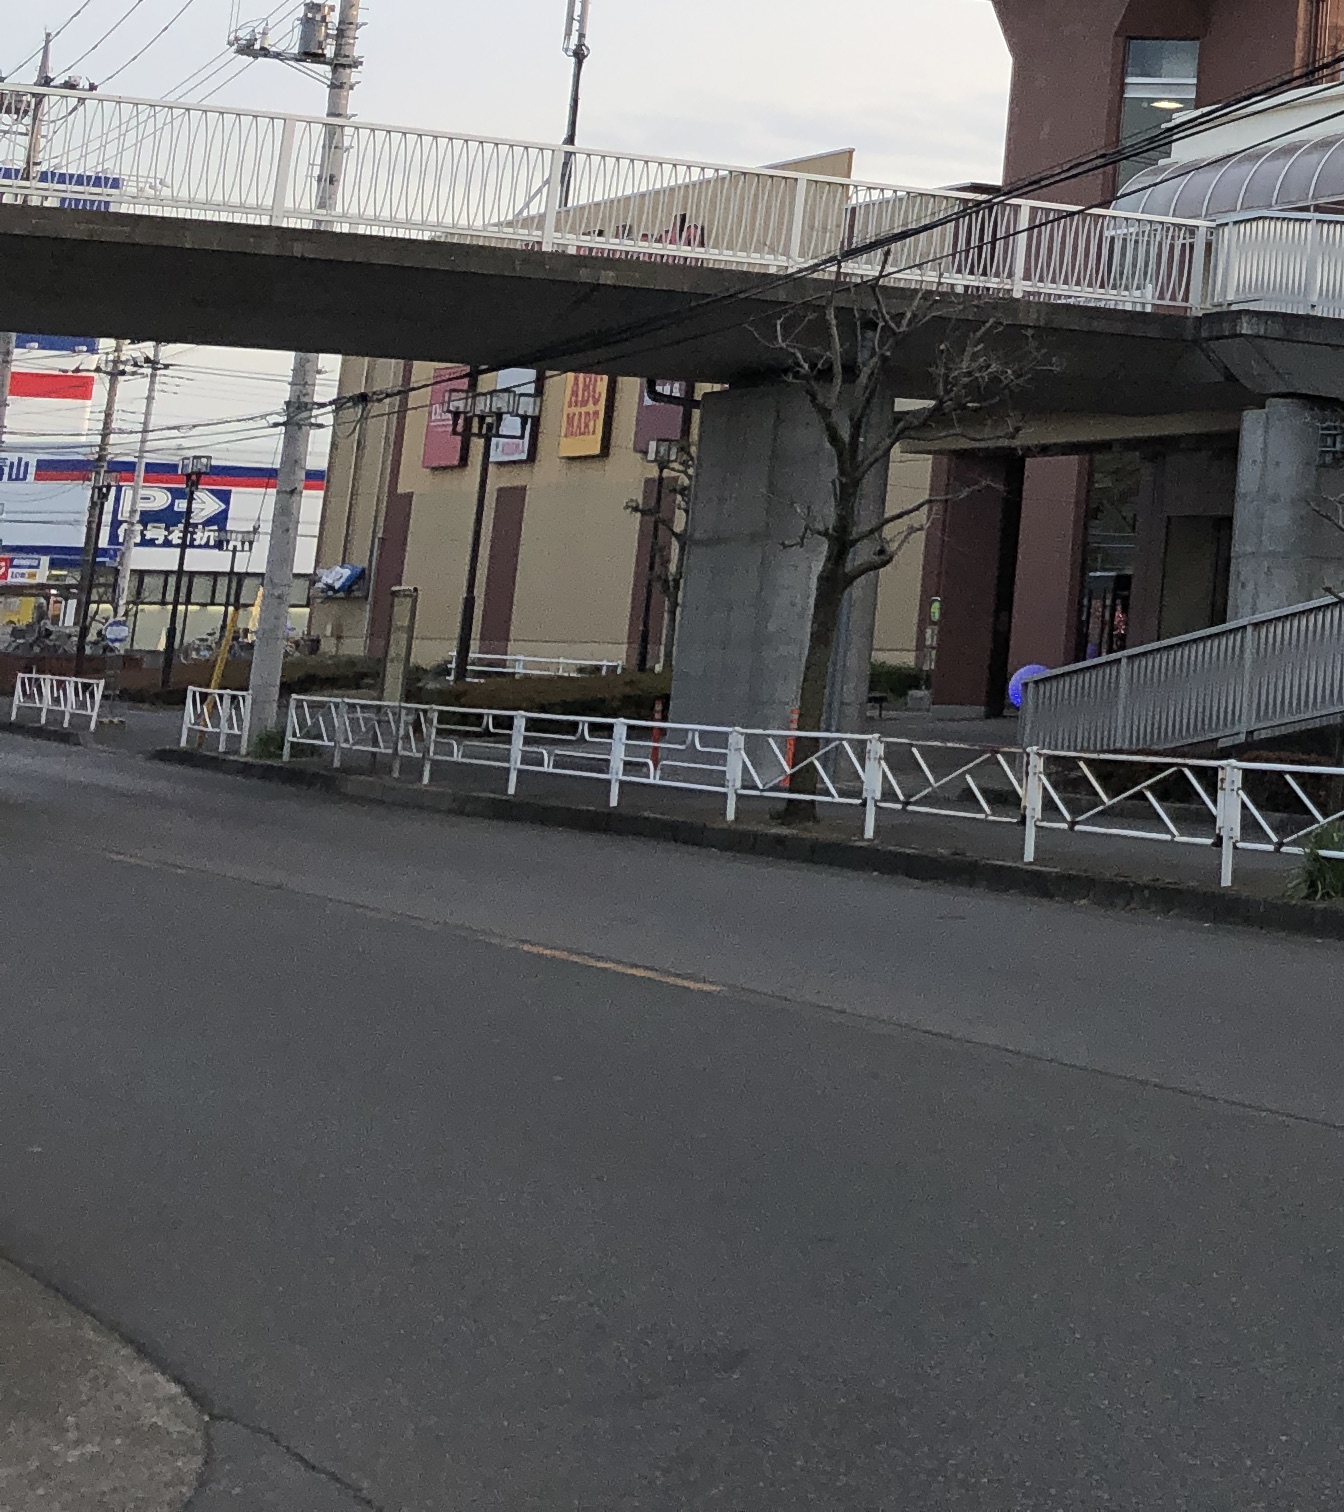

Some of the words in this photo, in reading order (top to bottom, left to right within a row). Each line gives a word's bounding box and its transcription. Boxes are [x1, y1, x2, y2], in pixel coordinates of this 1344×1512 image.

[567, 373, 604, 408] ABC
[564, 409, 600, 438] MART
[118, 486, 172, 522] P
